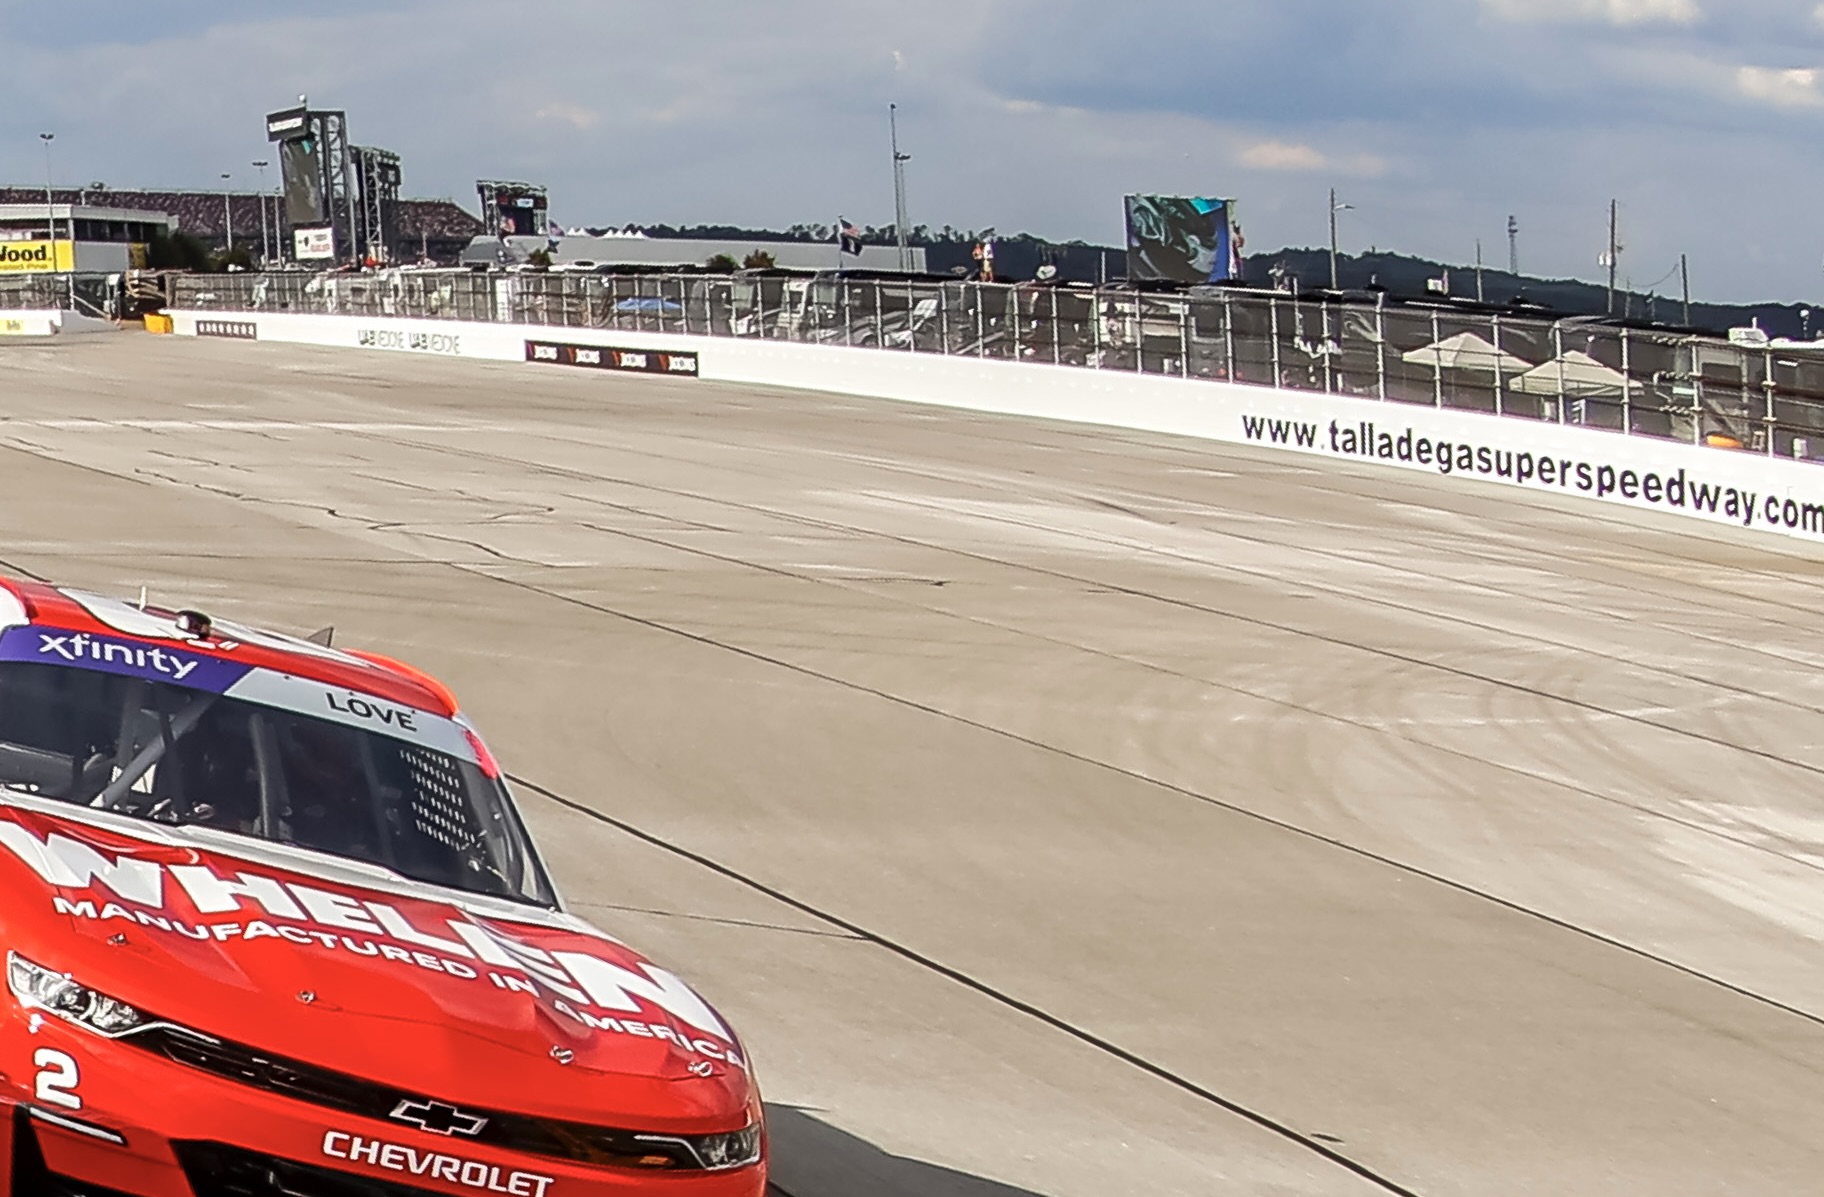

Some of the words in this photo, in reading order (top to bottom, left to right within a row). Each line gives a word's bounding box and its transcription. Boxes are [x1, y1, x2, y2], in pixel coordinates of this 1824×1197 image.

[38, 633, 199, 680] xfinity
[325, 691, 418, 732] LOVE
[53, 897, 478, 982] MANUFACTURED
[490, 974, 542, 1000] IN
[554, 999, 741, 1067] AMERICA
[33, 1047, 82, 1111] 2
